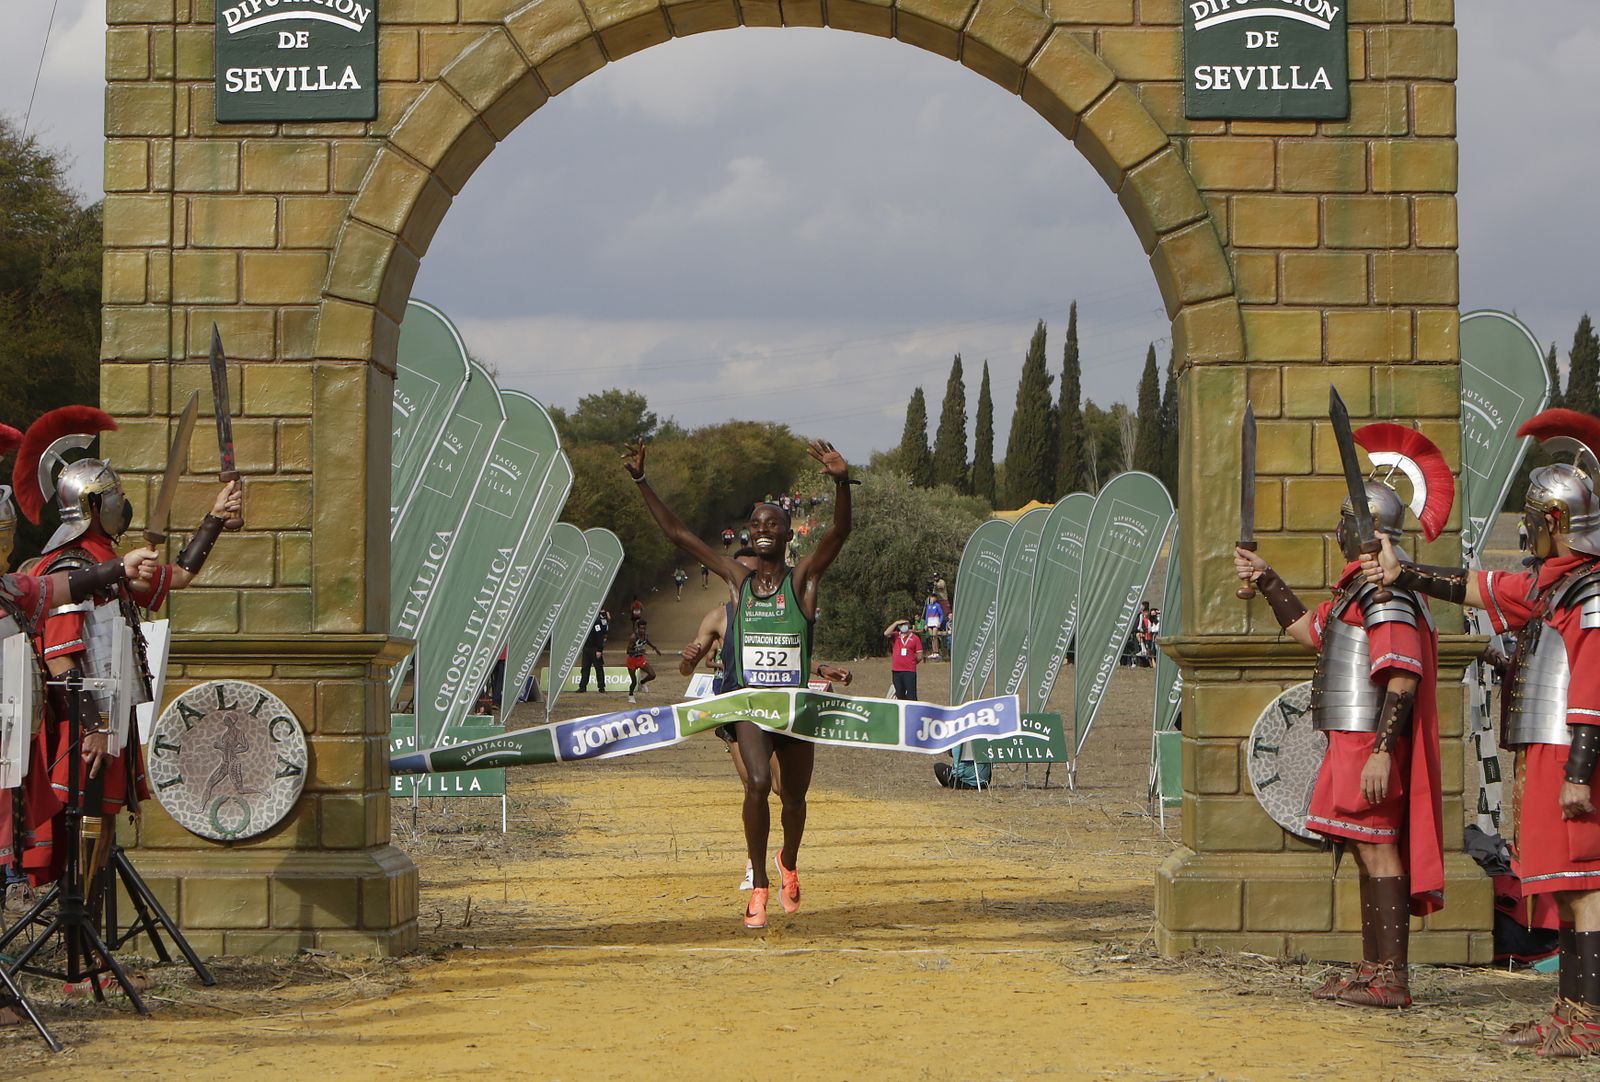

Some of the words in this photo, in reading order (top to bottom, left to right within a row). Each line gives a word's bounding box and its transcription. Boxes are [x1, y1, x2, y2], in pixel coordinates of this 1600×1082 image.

[222, 0, 371, 27] DIPON
[278, 32, 309, 49] DE
[1246, 31, 1279, 48] DE
[225, 66, 361, 92] SEVILLA
[1194, 66, 1333, 90] SEVILLA
[398, 530, 453, 633] ITÁLICA
[435, 642, 472, 712] CROSS
[464, 547, 513, 637] ITÁLICA
[557, 645, 577, 679] CROSS
[574, 601, 600, 648] ITÁLICA
[514, 651, 535, 687] CROSS
[532, 602, 561, 652] ITÁLICA
[1038, 654, 1060, 699] CROSS
[1055, 593, 1078, 652] ITÁLIC
[1087, 653, 1114, 705] CROSS
[1108, 584, 1142, 657] ITÁLICA
[755, 651, 788, 667] 252
[960, 649, 979, 686] CROSS
[1005, 654, 1027, 695] CROSS
[817, 700, 871, 717] DIPUTACION
[814, 727, 869, 741] SEVILLA
[1012, 738, 1024, 746] DE
[461, 741, 522, 761] DIPUTACION
[988, 747, 1054, 758] SEVILLA
